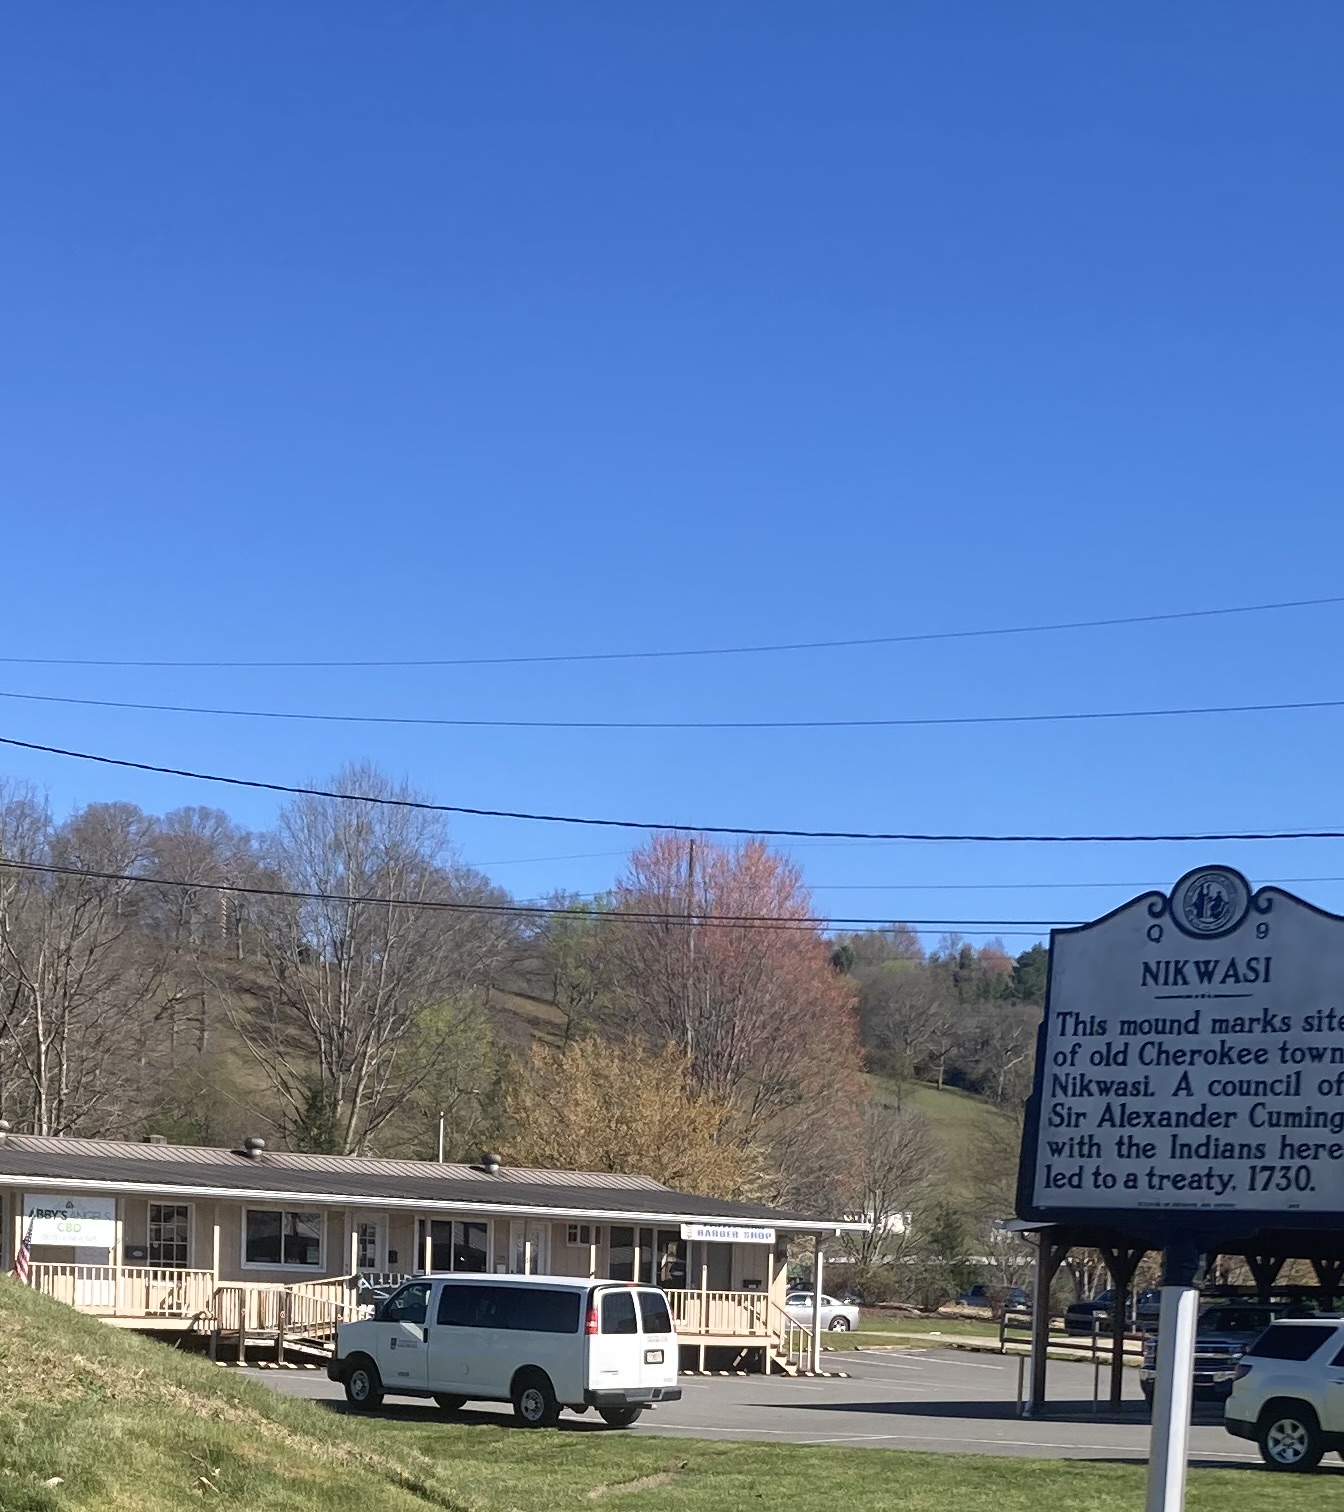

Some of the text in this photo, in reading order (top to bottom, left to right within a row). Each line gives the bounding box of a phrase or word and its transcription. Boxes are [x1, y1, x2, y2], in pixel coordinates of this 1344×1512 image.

[1147, 922, 1270, 943] Q 9
[1140, 956, 1273, 987] NIKWASI
[1057, 1011, 1108, 1037] This
[1119, 1010, 1201, 1036] mound
[1211, 1007, 1292, 1034] marks
[1053, 1042, 1082, 1067] of
[1089, 1042, 1129, 1067] old
[1138, 1039, 1270, 1066] Cherokee
[1171, 1070, 1194, 1097] A
[1208, 1070, 1303, 1097] council
[1048, 1103, 1087, 1128] Sir
[1097, 1102, 1238, 1129] Alexander
[1047, 1134, 1344, 1160] with the Indians here
[1044, 1164, 1084, 1190] led
[1092, 1166, 1117, 1190] to
[1123, 1172, 1138, 1190] a
[1248, 1165, 1316, 1192] 1730.
[57, 1222, 82, 1232] CBD
[743, 1231, 772, 1240] SHOP
